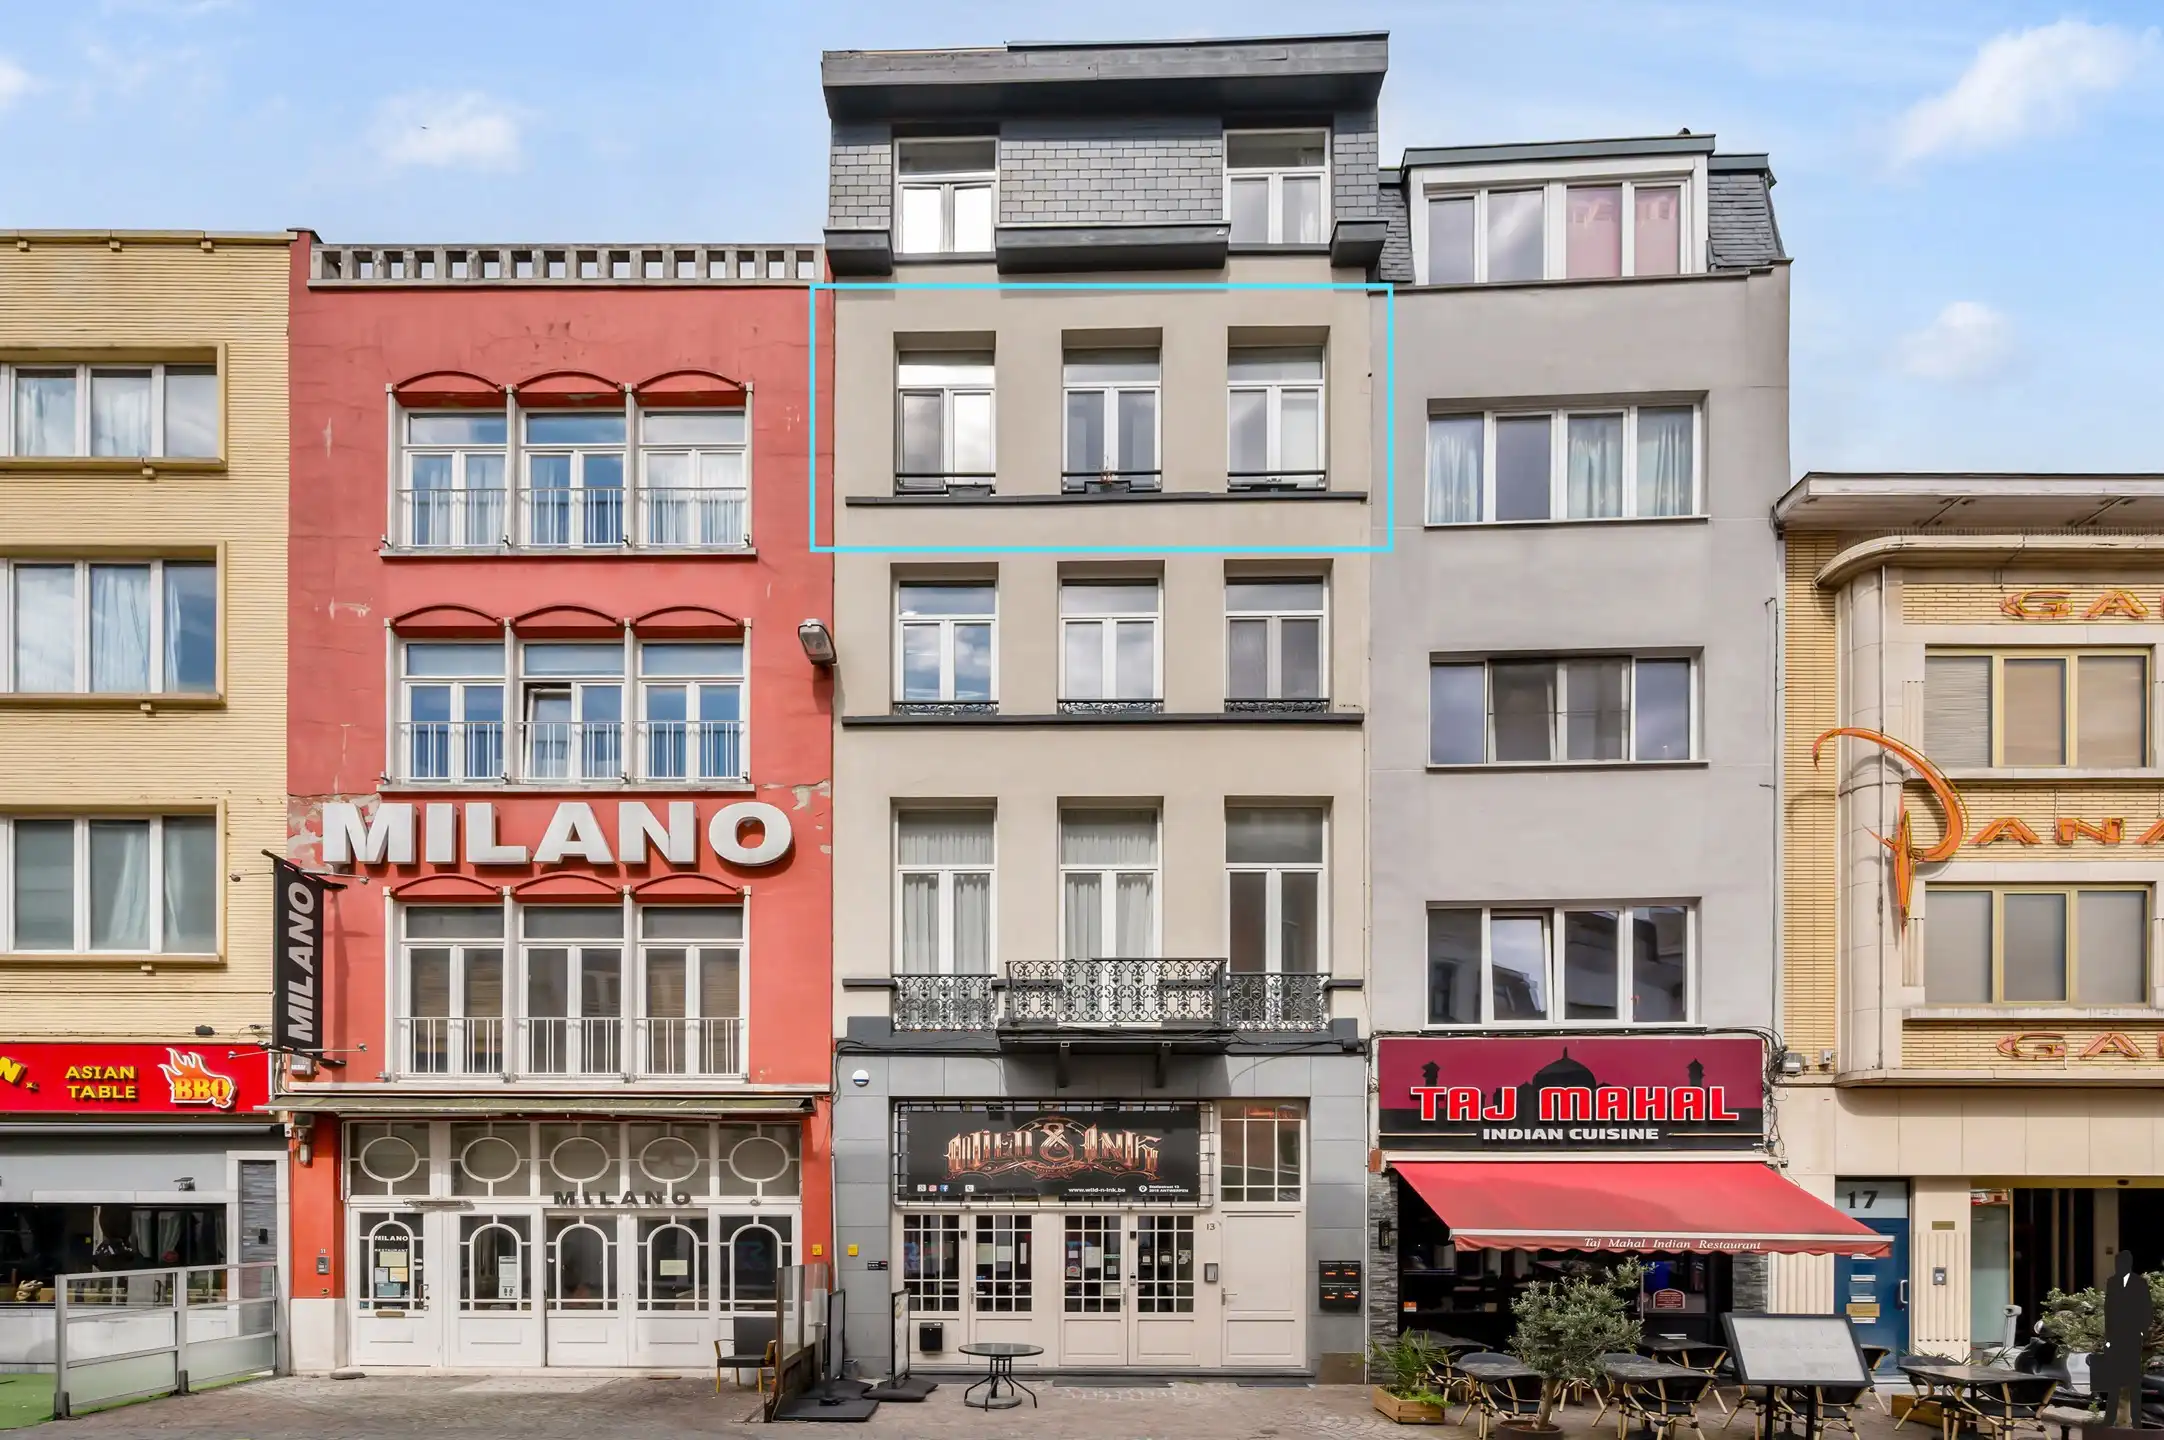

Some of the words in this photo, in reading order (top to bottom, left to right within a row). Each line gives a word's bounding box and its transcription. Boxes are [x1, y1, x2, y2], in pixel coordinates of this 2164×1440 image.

[2000, 591, 2164, 619] GA
[322, 801, 793, 867] MILANO
[287, 881, 315, 1043] MILANO
[1997, 1033, 2164, 1058] GA
[65, 1066, 135, 1079] ASIAN
[67, 1085, 136, 1099] TABLE
[175, 1078, 231, 1106] BBQ
[1410, 1086, 1517, 1121] TAJ
[1538, 1086, 1740, 1121] MAHAL
[1483, 1128, 1563, 1140] INDIAN
[1569, 1128, 1659, 1140] CUISINE
[553, 1190, 691, 1206] MILANO
[1848, 1190, 1879, 1209] 17
[1206, 1223, 1216, 1231] 13
[1585, 1238, 1601, 1248] Taj
[1608, 1239, 1646, 1248] Mahal
[1653, 1239, 1691, 1249] Indian
[1699, 1240, 1761, 1250] Restaurant
